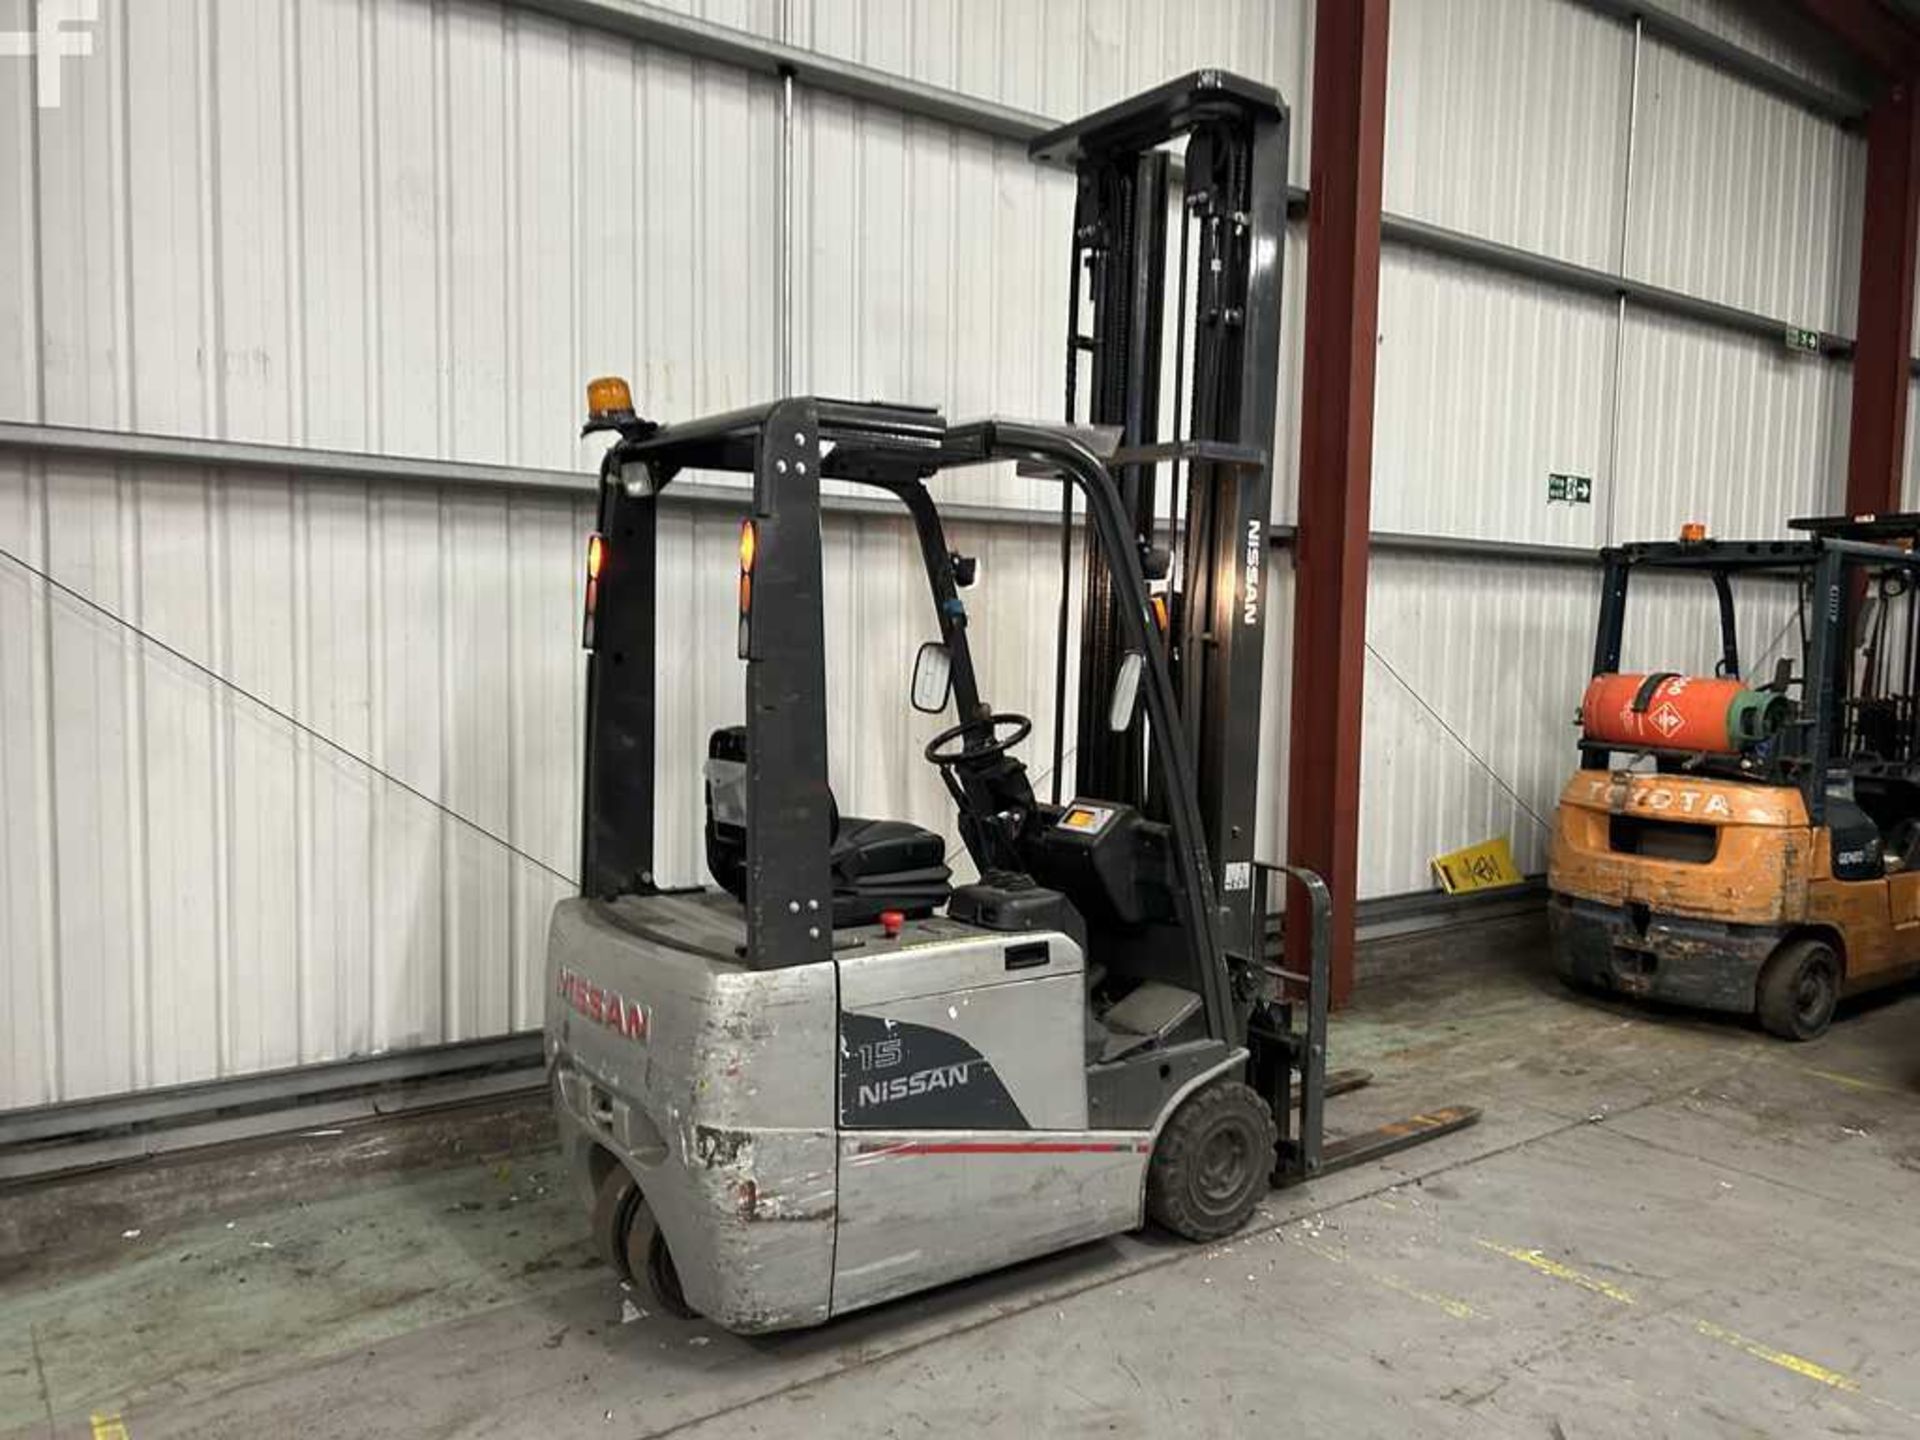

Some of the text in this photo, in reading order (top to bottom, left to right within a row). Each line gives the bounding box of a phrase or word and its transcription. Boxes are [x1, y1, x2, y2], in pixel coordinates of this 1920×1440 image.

[1244, 519, 1261, 624] NISSAN
[558, 964, 653, 1043] NISSAN
[859, 1039, 902, 1071] 15
[859, 1064, 969, 1107] NISSAN
